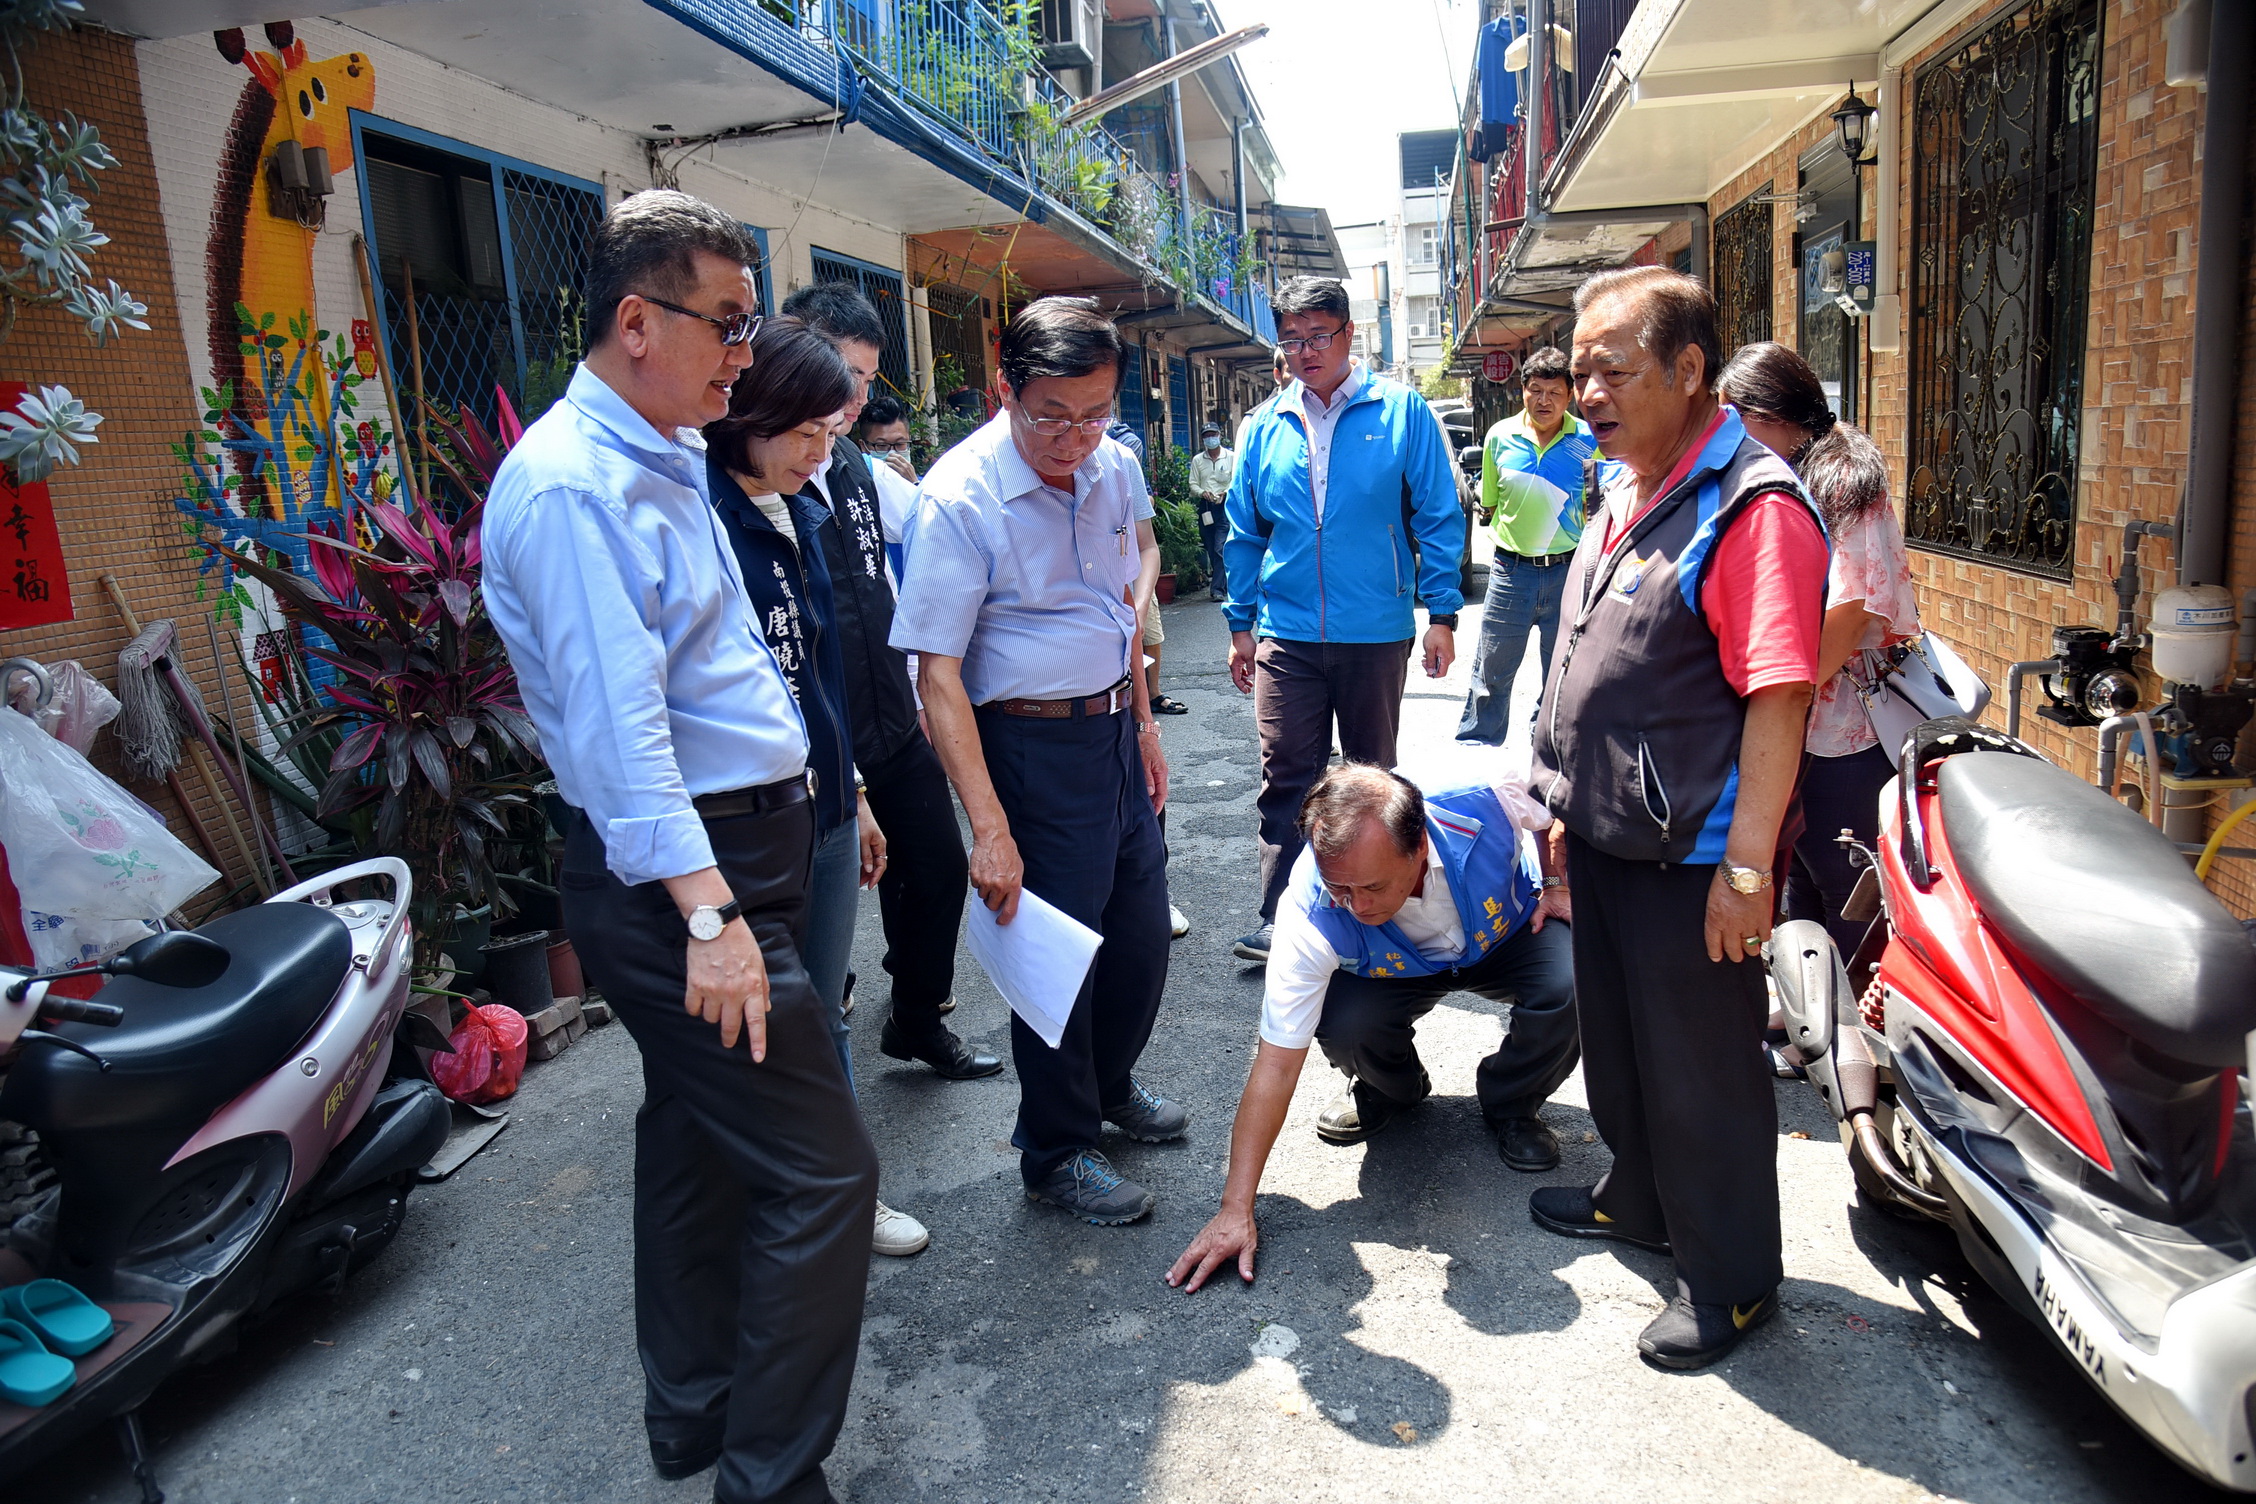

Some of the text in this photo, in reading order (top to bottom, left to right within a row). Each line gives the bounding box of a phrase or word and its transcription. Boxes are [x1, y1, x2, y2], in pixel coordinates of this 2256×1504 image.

[1848, 252, 1863, 285] 220-5000
[1487, 354, 1509, 365] 廣告
[1487, 366, 1509, 378] 設計
[847, 498, 877, 580] 許淑華
[772, 560, 806, 660] 南投縣議員
[2034, 1265, 2107, 1386] YAMAHA
